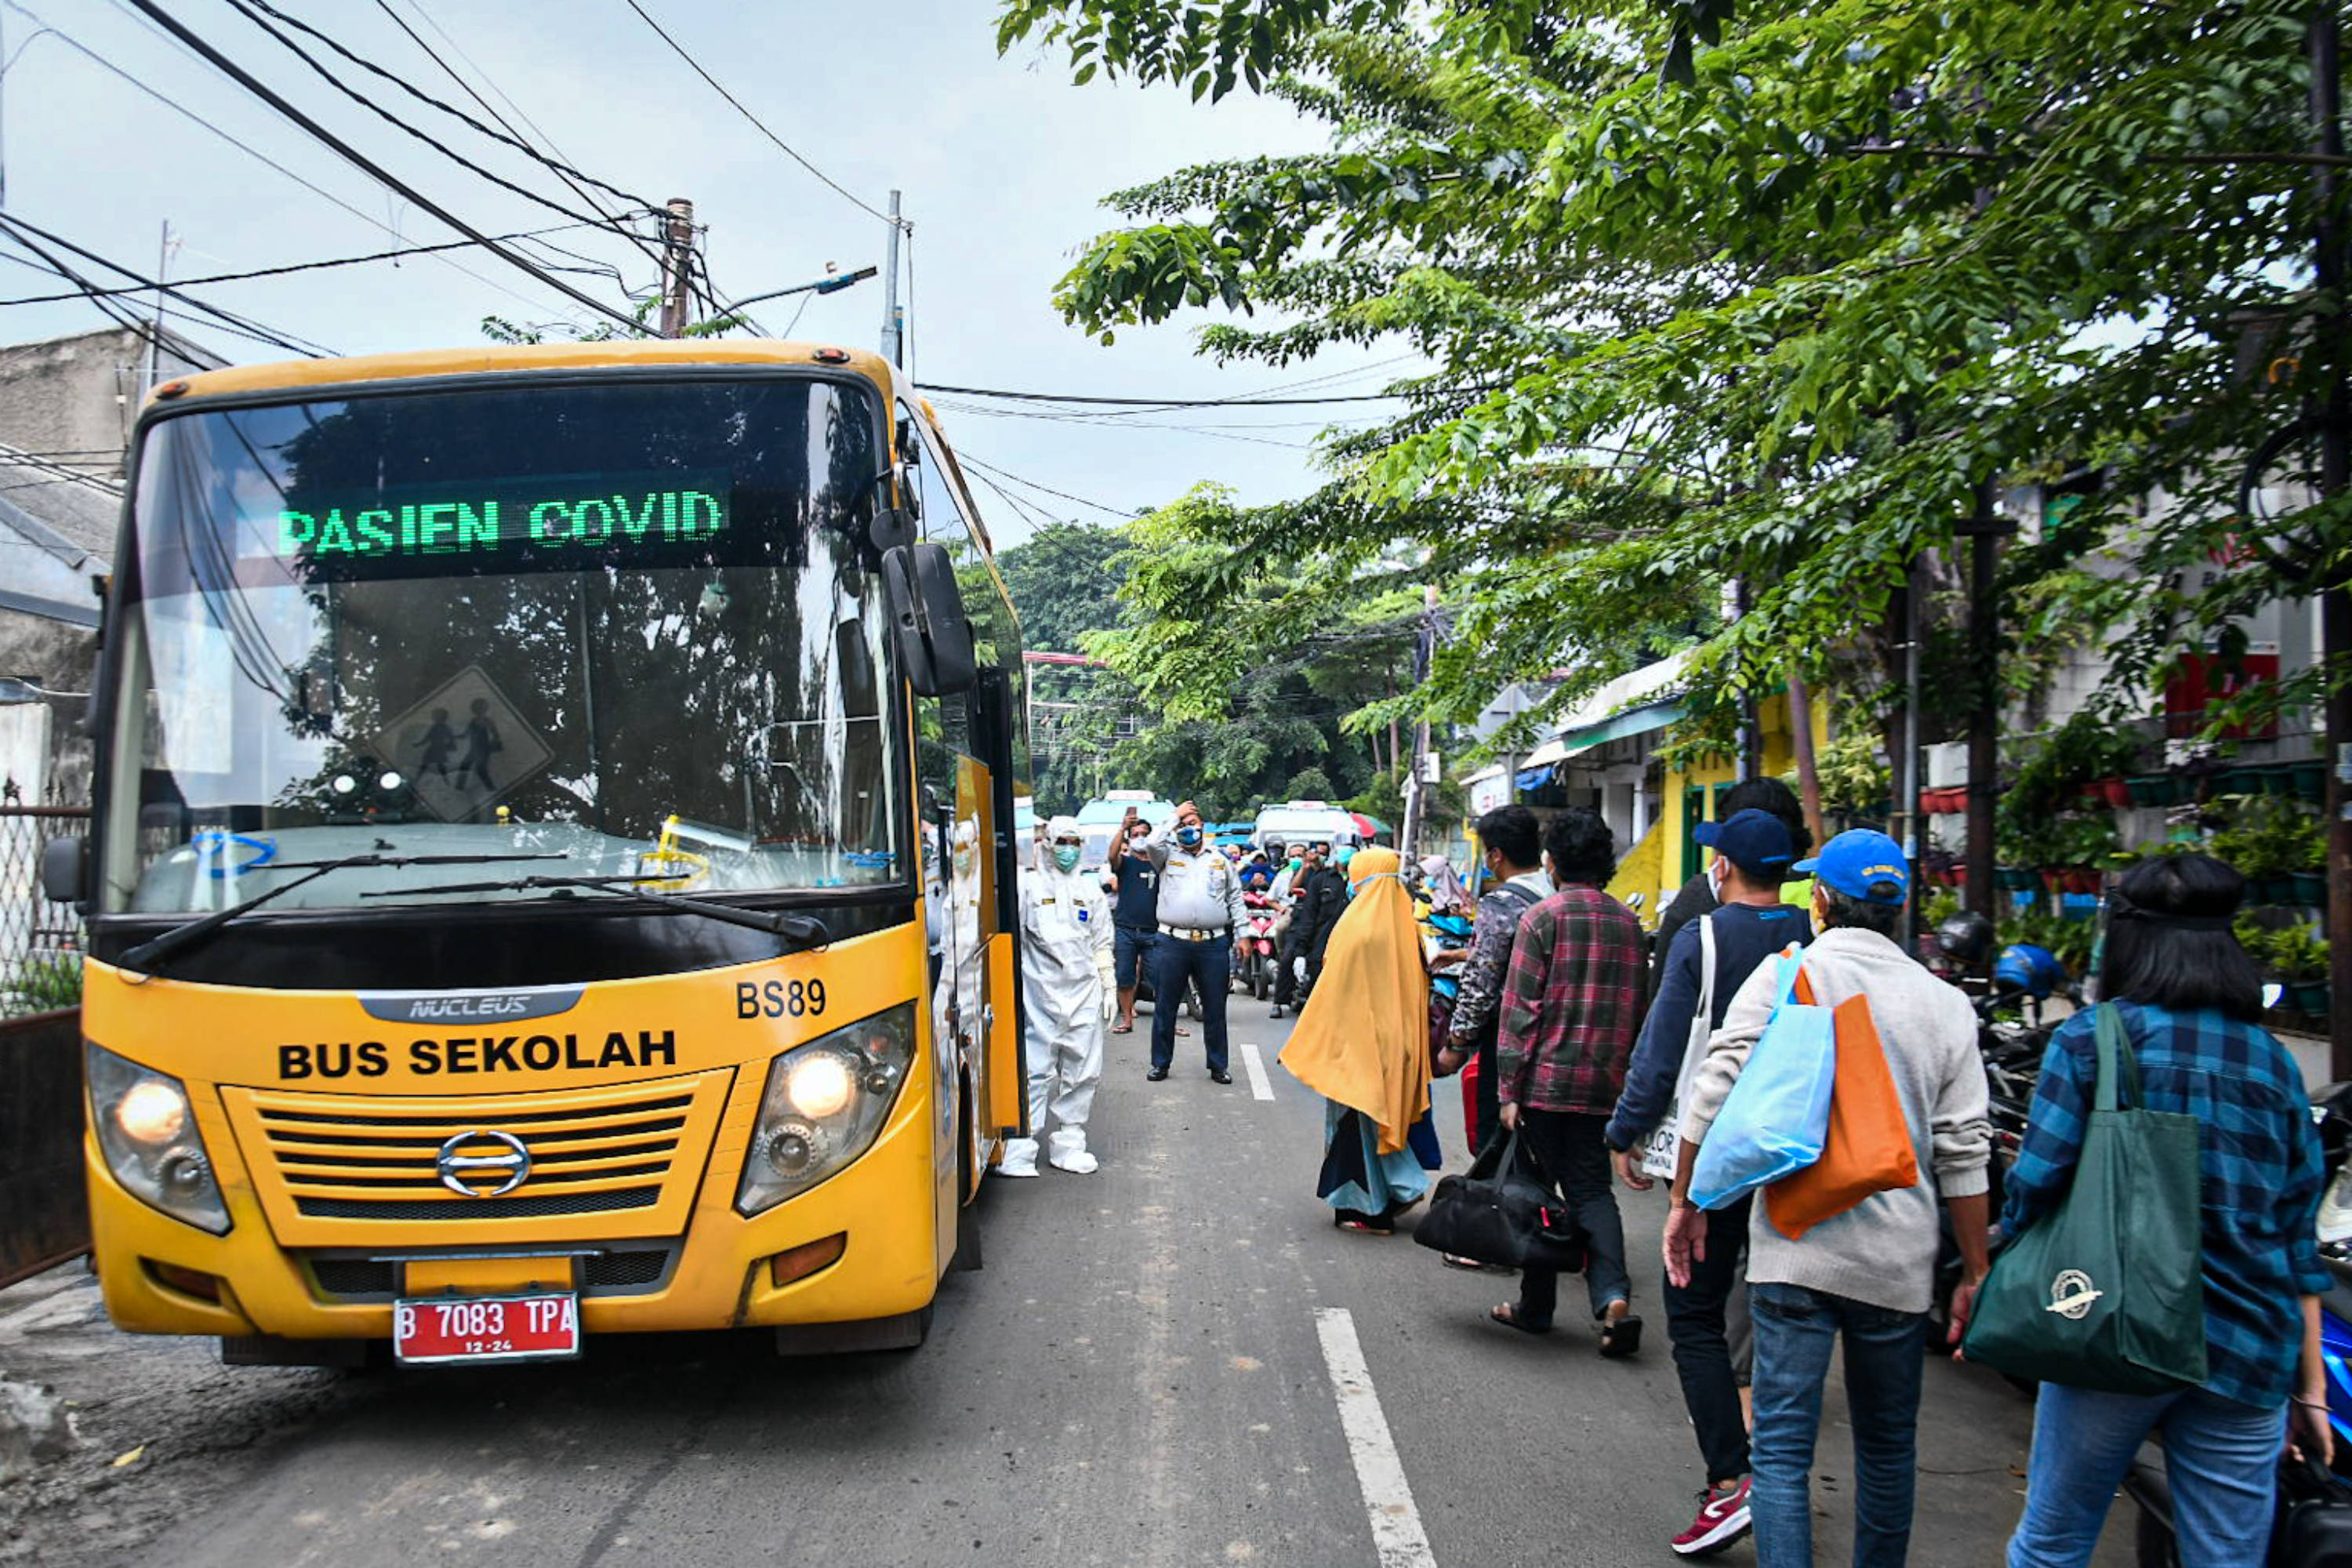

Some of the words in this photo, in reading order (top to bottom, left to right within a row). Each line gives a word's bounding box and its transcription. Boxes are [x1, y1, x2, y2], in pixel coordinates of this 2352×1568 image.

[278, 502, 499, 557] PASIEN
[528, 491, 721, 548] COVID
[409, 995, 532, 1018] NUCLEUS
[735, 978, 826, 1019] BS89
[278, 1042, 388, 1080] BUS
[409, 1030, 677, 1074] SEKOLAH
[401, 1307, 416, 1339] B
[436, 1303, 504, 1338] 7083
[524, 1299, 575, 1334] TPA
